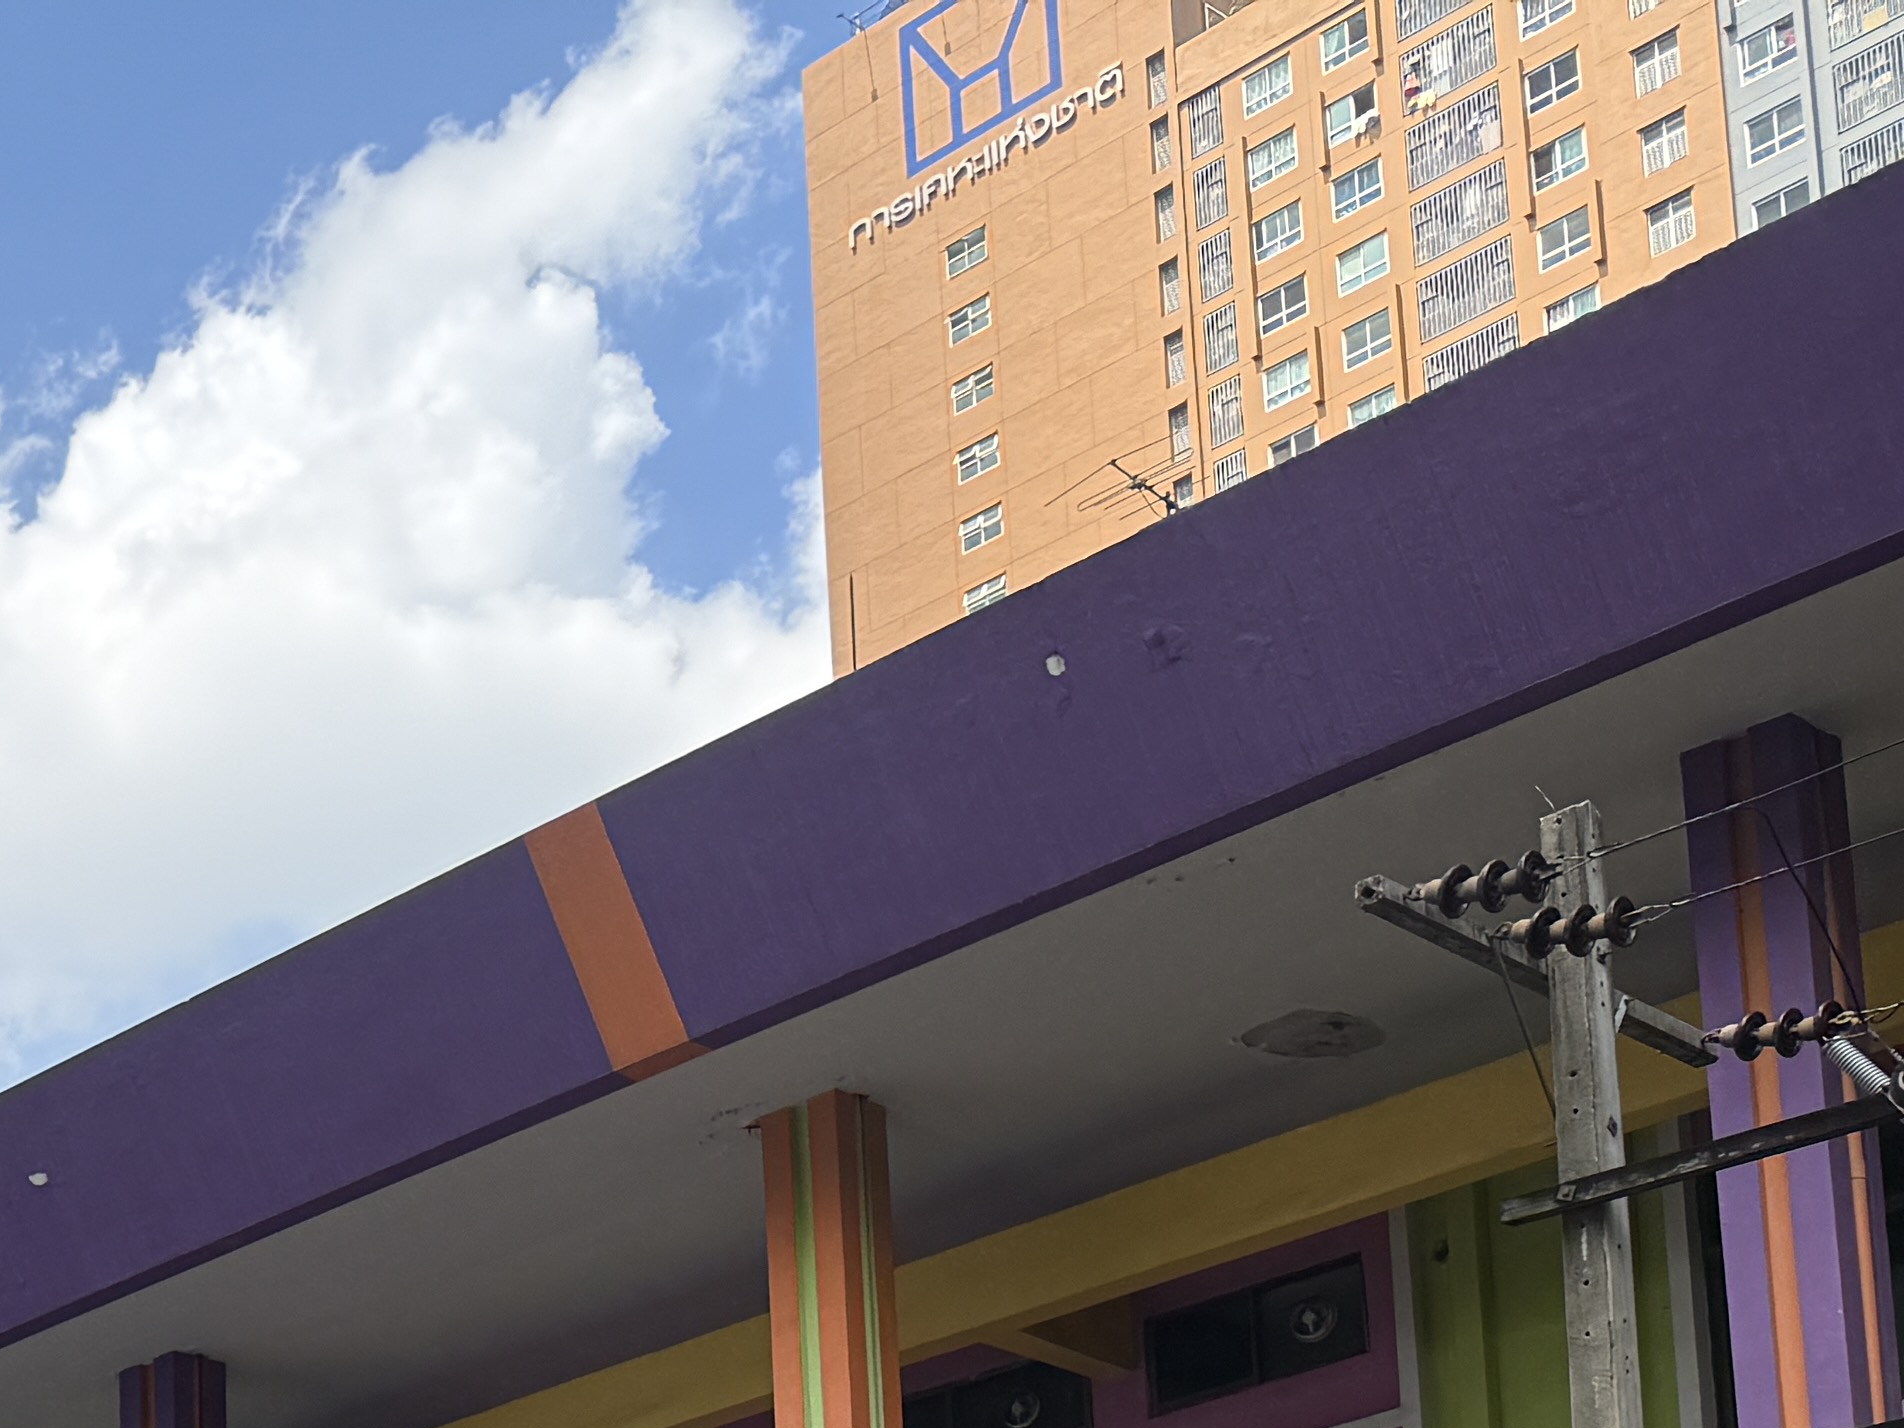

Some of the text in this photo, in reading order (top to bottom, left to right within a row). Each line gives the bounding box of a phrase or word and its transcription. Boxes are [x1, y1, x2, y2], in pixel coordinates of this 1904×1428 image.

[848, 59, 1124, 249] การเคหะแห่งชาติ
